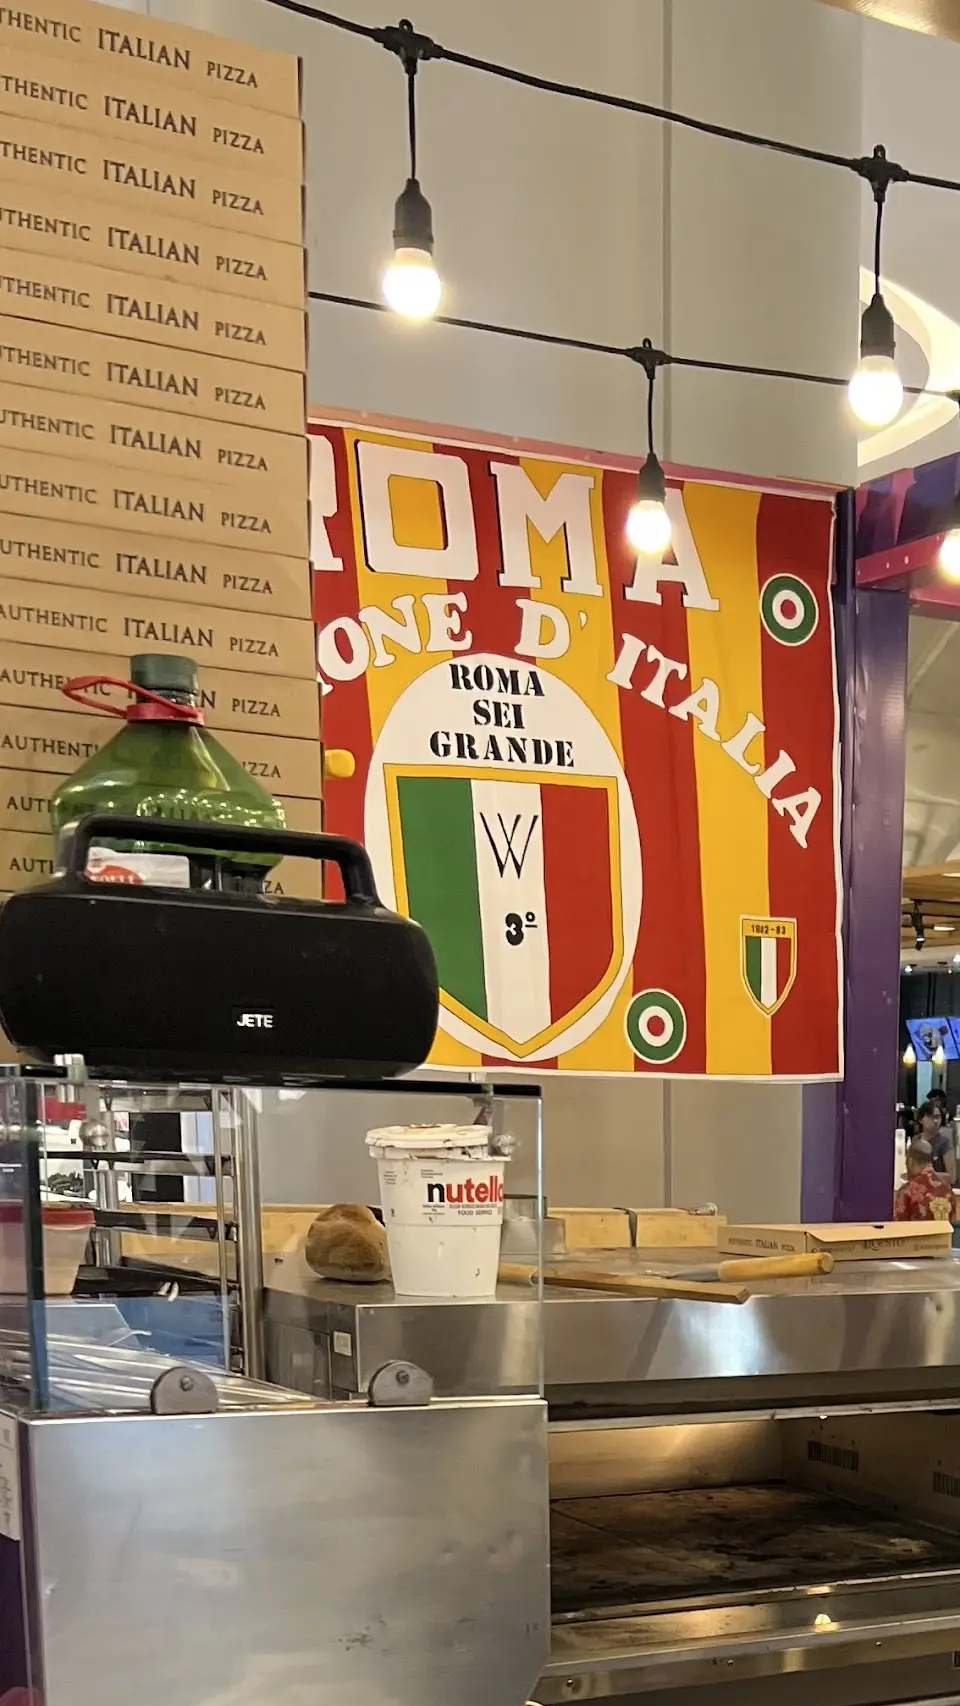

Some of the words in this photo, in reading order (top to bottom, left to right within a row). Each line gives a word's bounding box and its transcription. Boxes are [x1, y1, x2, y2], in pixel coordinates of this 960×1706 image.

[97, 28, 190, 70] ITALIAN
[206, 61, 257, 88] PIZZA
[0, 75, 88, 110] THENTIC
[103, 96, 196, 136] ITALIAN
[212, 127, 264, 154] PIZZA
[0, 140, 86, 174] THENTIC
[102, 159, 195, 199] ITALIAN
[212, 190, 264, 215] PIZZA
[0, 207, 91, 241] THENTIC
[107, 227, 199, 265] ITALIAN
[215, 256, 267, 280] PIZZA
[0, 275, 89, 308] THENTIC
[106, 294, 199, 331] ITALIAN
[214, 321, 266, 345] PIZZA
[0, 345, 90, 376] THENTIC
[106, 362, 198, 397] ITALIAN
[214, 387, 265, 410] PIZZA
[109, 424, 201, 459] ITALIAN
[217, 449, 267, 471] PIZZA
[0, 474, 96, 504] UTHENTIC
[113, 489, 204, 522] ITALIAN
[220, 512, 271, 534] PIZZA
[0, 539, 99, 568] UTHENTIC
[115, 553, 207, 584] ITALIAN
[222, 574, 272, 594] PIZZA
[123, 617, 213, 647] ITALIAN
[229, 637, 278, 657] PIZZA
[316, 592, 473, 694] ONE
[232, 698, 281, 717] PIZZA
[449, 664, 545, 697] ROMA
[473, 700, 525, 729] SEI
[430, 731, 574, 768] GRANDE
[236, 1013, 274, 1028] JETE
